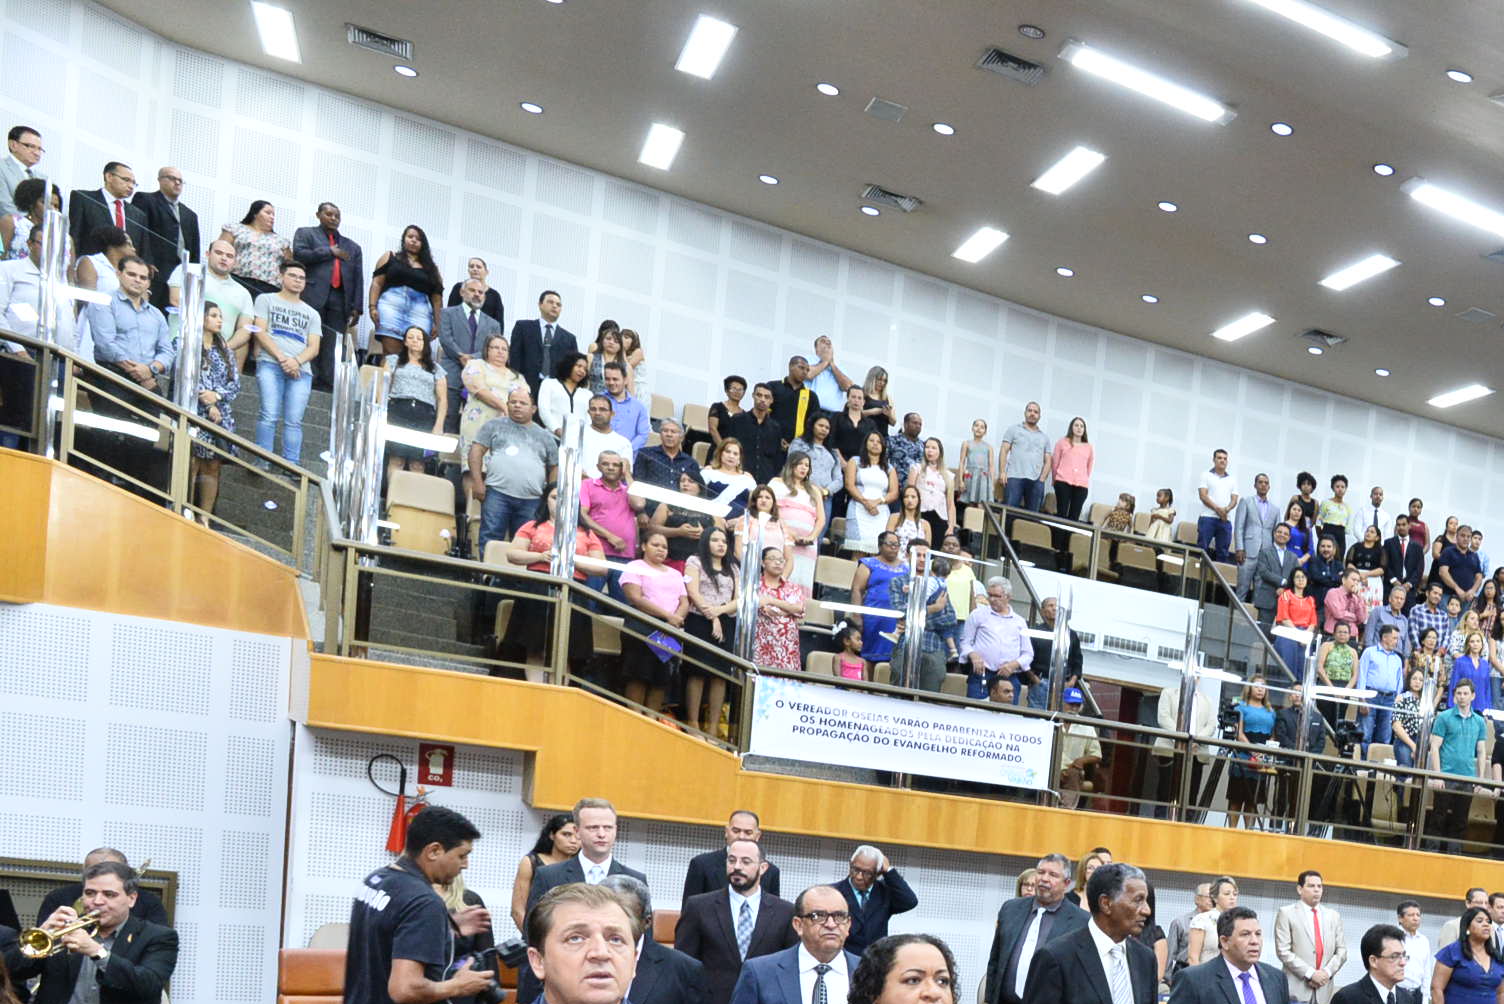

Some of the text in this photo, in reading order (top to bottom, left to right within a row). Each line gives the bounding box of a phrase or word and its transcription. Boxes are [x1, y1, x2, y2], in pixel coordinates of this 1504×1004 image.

[775, 699, 784, 708] O
[788, 701, 848, 717] VEREADOR
[933, 722, 996, 739] PARABENIZA
[1009, 733, 1043, 745] TODOS
[799, 714, 815, 725] OS
[819, 717, 914, 738] HOMENAGEADOS
[1006, 743, 1020, 753] NA
[873, 736, 890, 745] DO
[893, 738, 958, 754] EVANGELHO
